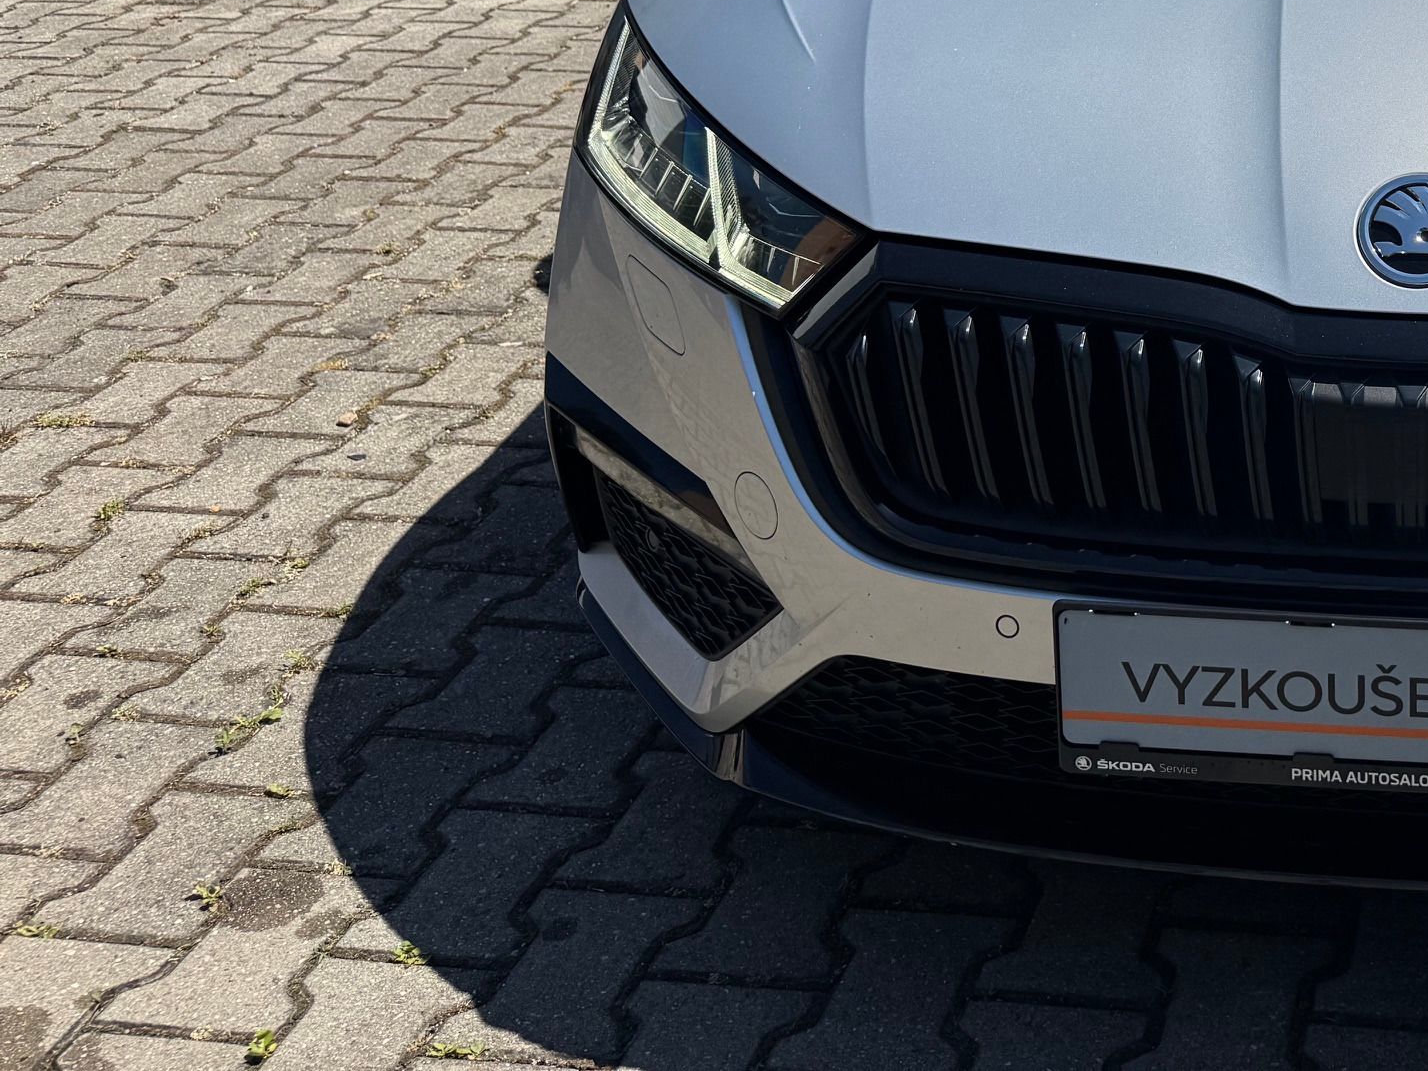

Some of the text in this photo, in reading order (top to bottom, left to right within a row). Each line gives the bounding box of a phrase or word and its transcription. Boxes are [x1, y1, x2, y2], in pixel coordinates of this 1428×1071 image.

[1097, 758, 1198, 775] ŠKODA Service
[1291, 767, 1343, 783] PRIMA
